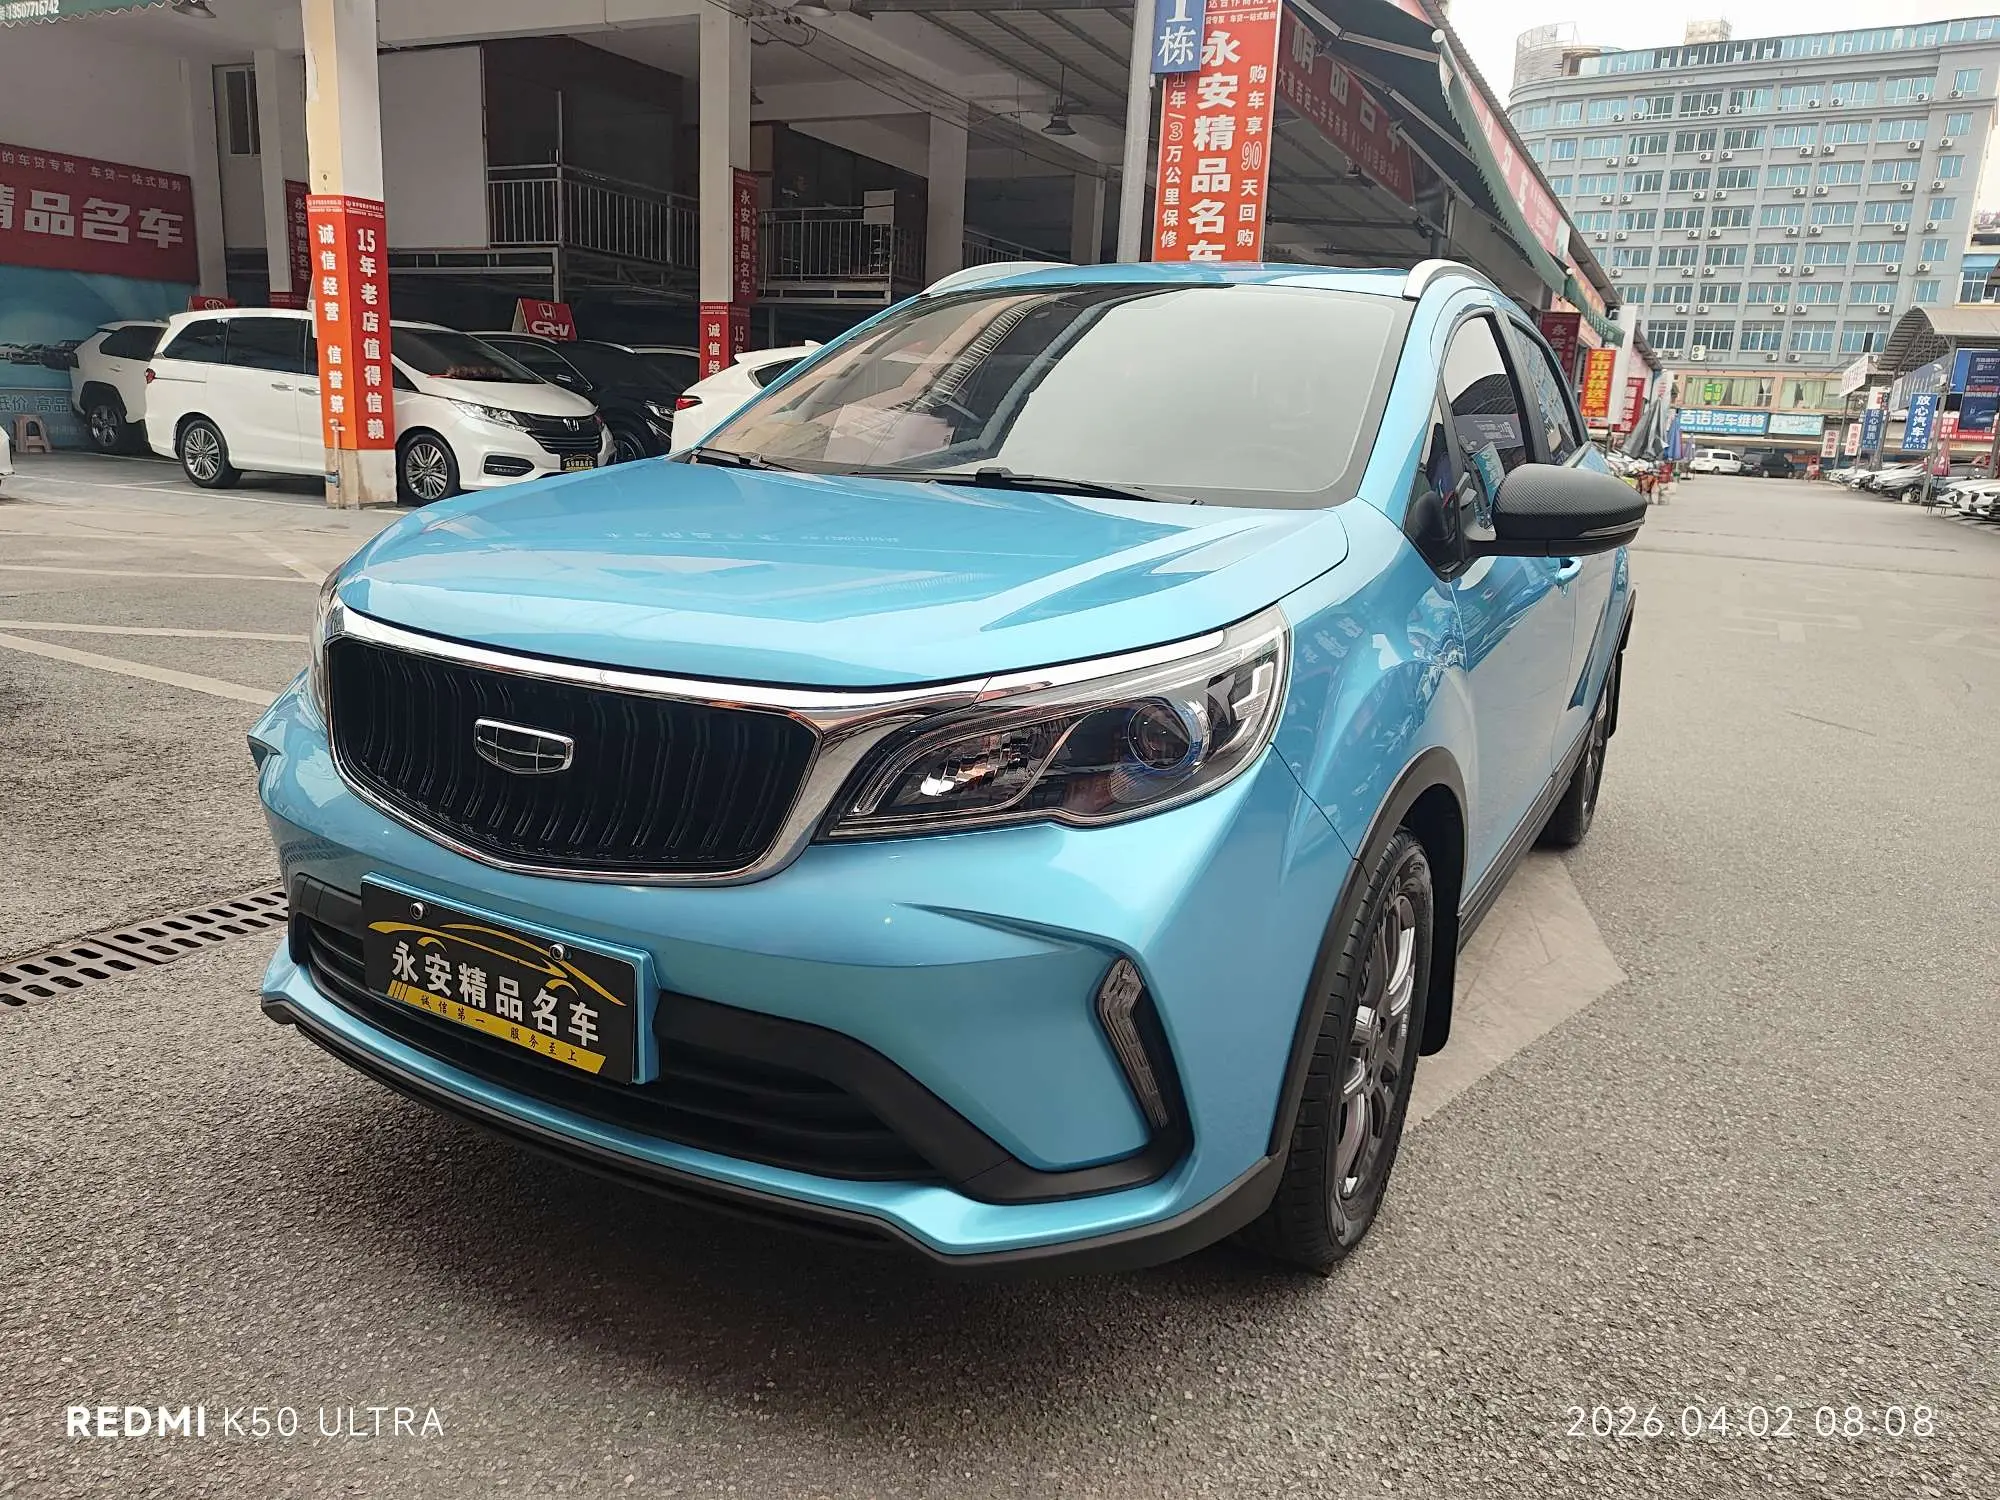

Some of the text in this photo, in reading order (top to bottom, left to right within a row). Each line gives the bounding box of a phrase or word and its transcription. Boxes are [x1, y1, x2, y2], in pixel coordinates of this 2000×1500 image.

[1236, 64, 1267, 247] 购车享90天回购
[317, 224, 339, 321] 诚信经营
[741, 189, 751, 296] 永安精品名车
[357, 228, 385, 439] 15年老店值得信赖
[531, 320, 570, 337] CR-V
[1911, 396, 1931, 436] 放心汽车
[391, 940, 600, 1047] 永安精品名车
[510, 1026, 578, 1063] 服务至上
